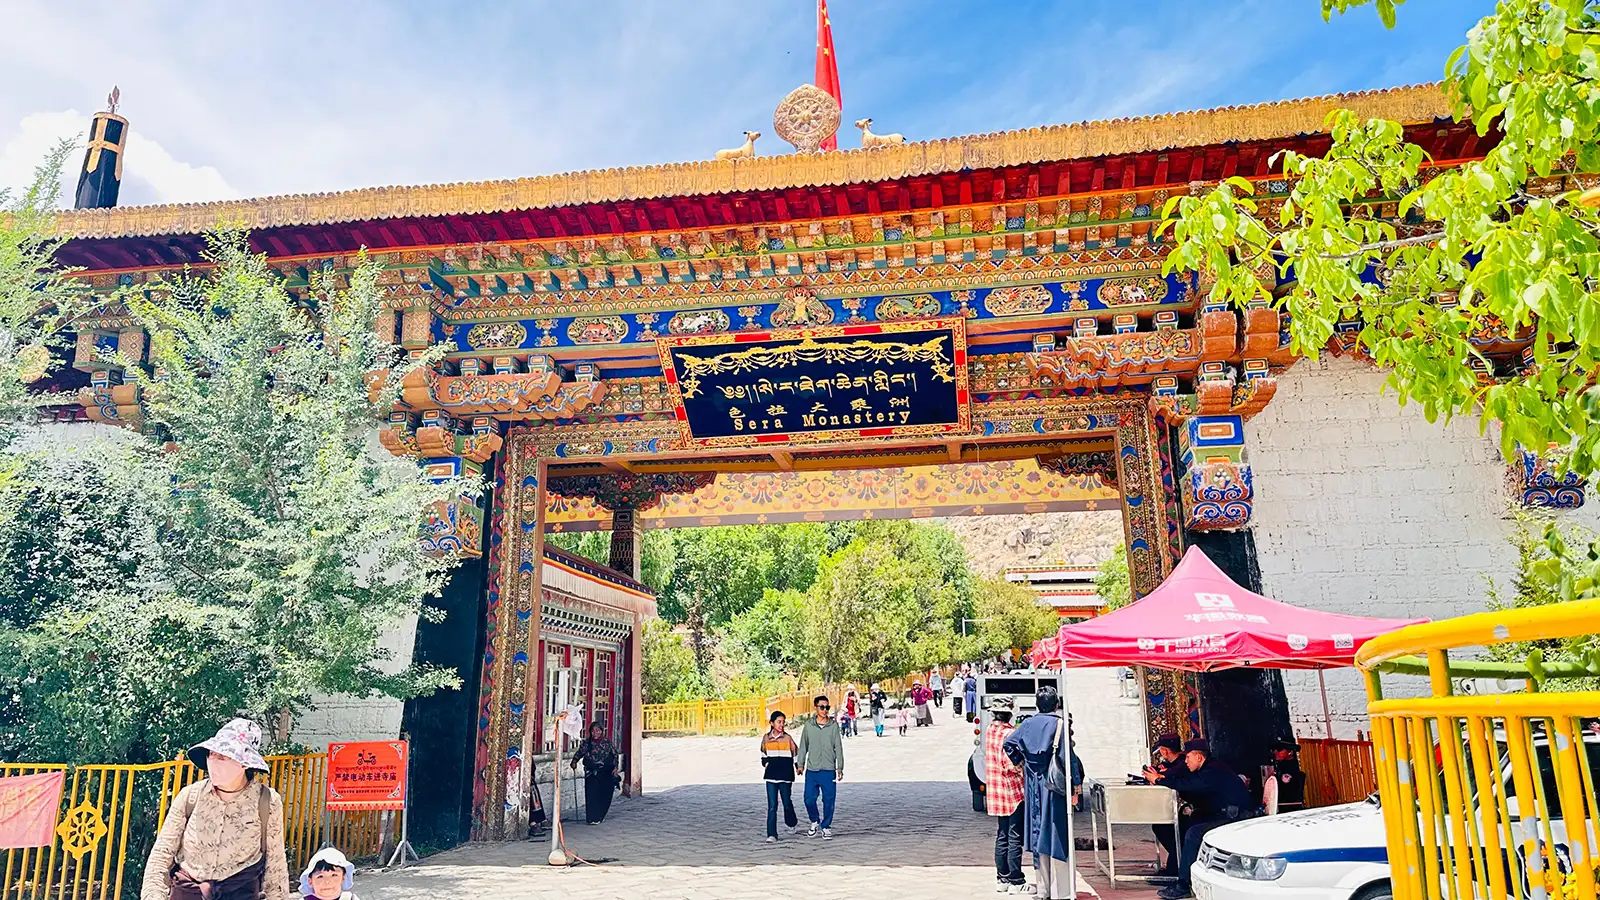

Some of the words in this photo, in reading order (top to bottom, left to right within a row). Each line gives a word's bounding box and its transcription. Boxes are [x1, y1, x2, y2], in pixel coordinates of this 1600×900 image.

[733, 418, 784, 431] Sera
[801, 411, 911, 427] Monastery
[334, 772, 397, 782] 严禁电动车进寺庙
